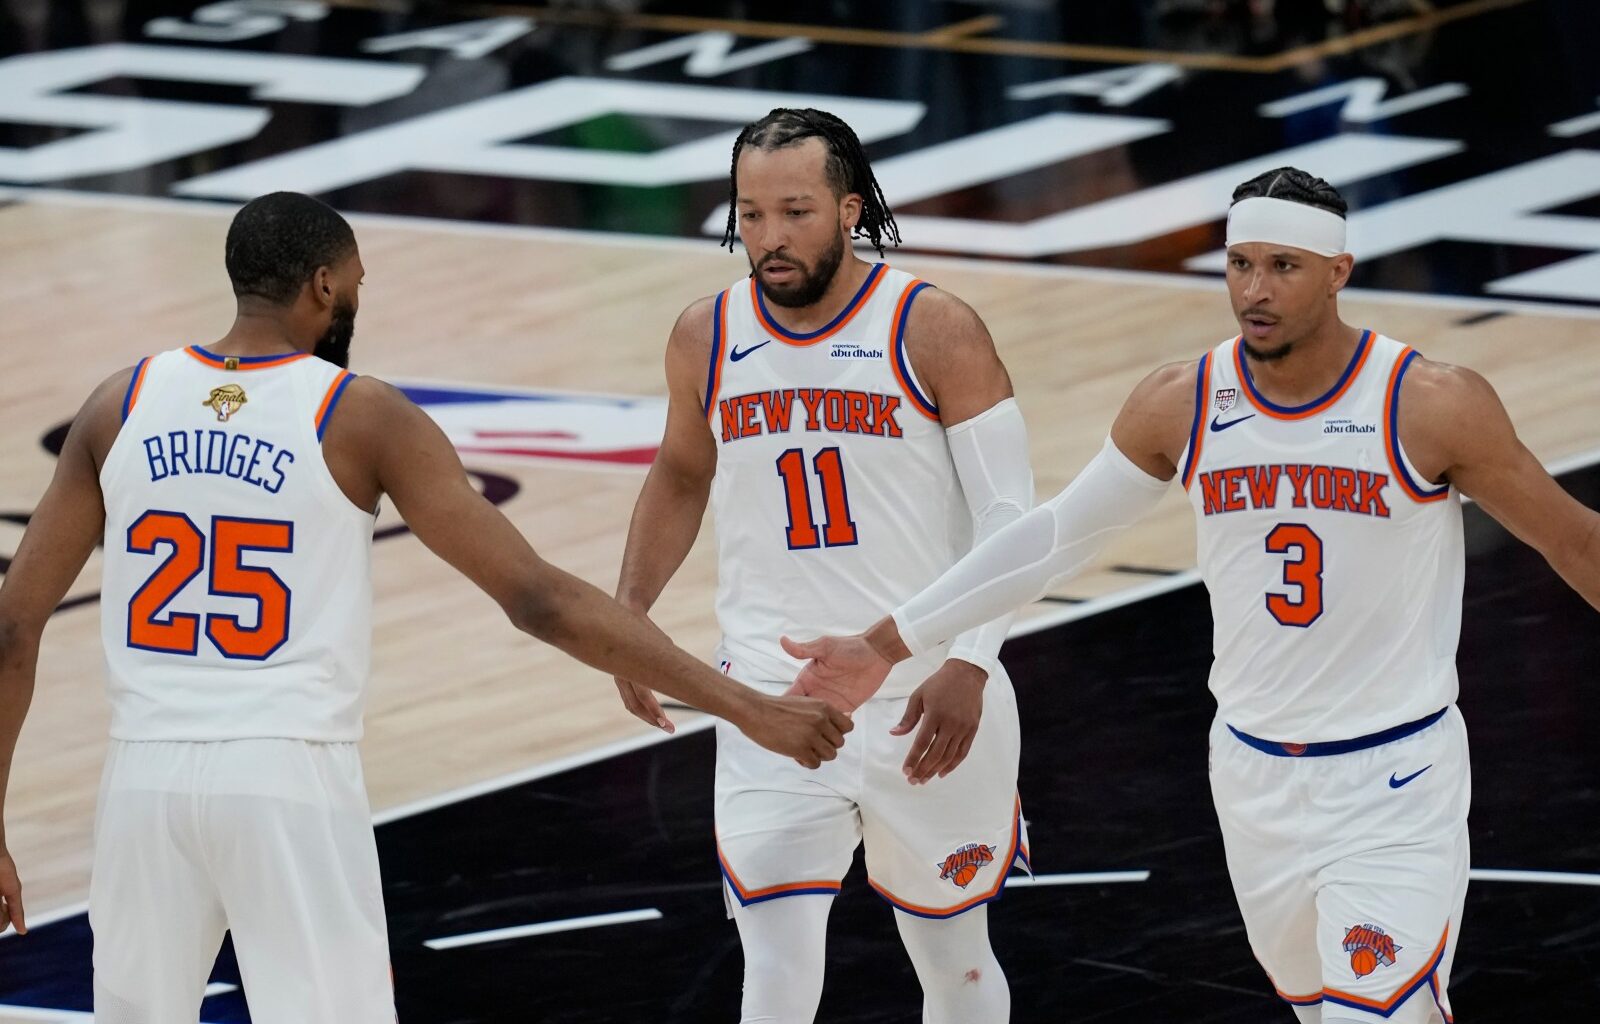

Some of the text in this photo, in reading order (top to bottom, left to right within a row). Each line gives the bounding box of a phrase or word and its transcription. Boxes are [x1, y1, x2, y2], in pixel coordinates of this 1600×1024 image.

[1006, 64, 1600, 138] AN
[831, 349, 883, 359] abu dhabi
[719, 388, 903, 444] NEW YORK
[1324, 424, 1376, 433] abu dhabi
[143, 429, 295, 494] BRIDGES
[775, 446, 859, 551] 11
[1199, 464, 1391, 519] NEW YORK
[126, 509, 294, 661] 25
[1264, 522, 1324, 629] 3
[939, 844, 994, 881] KNICKS
[1342, 924, 1396, 964] KNICKS
